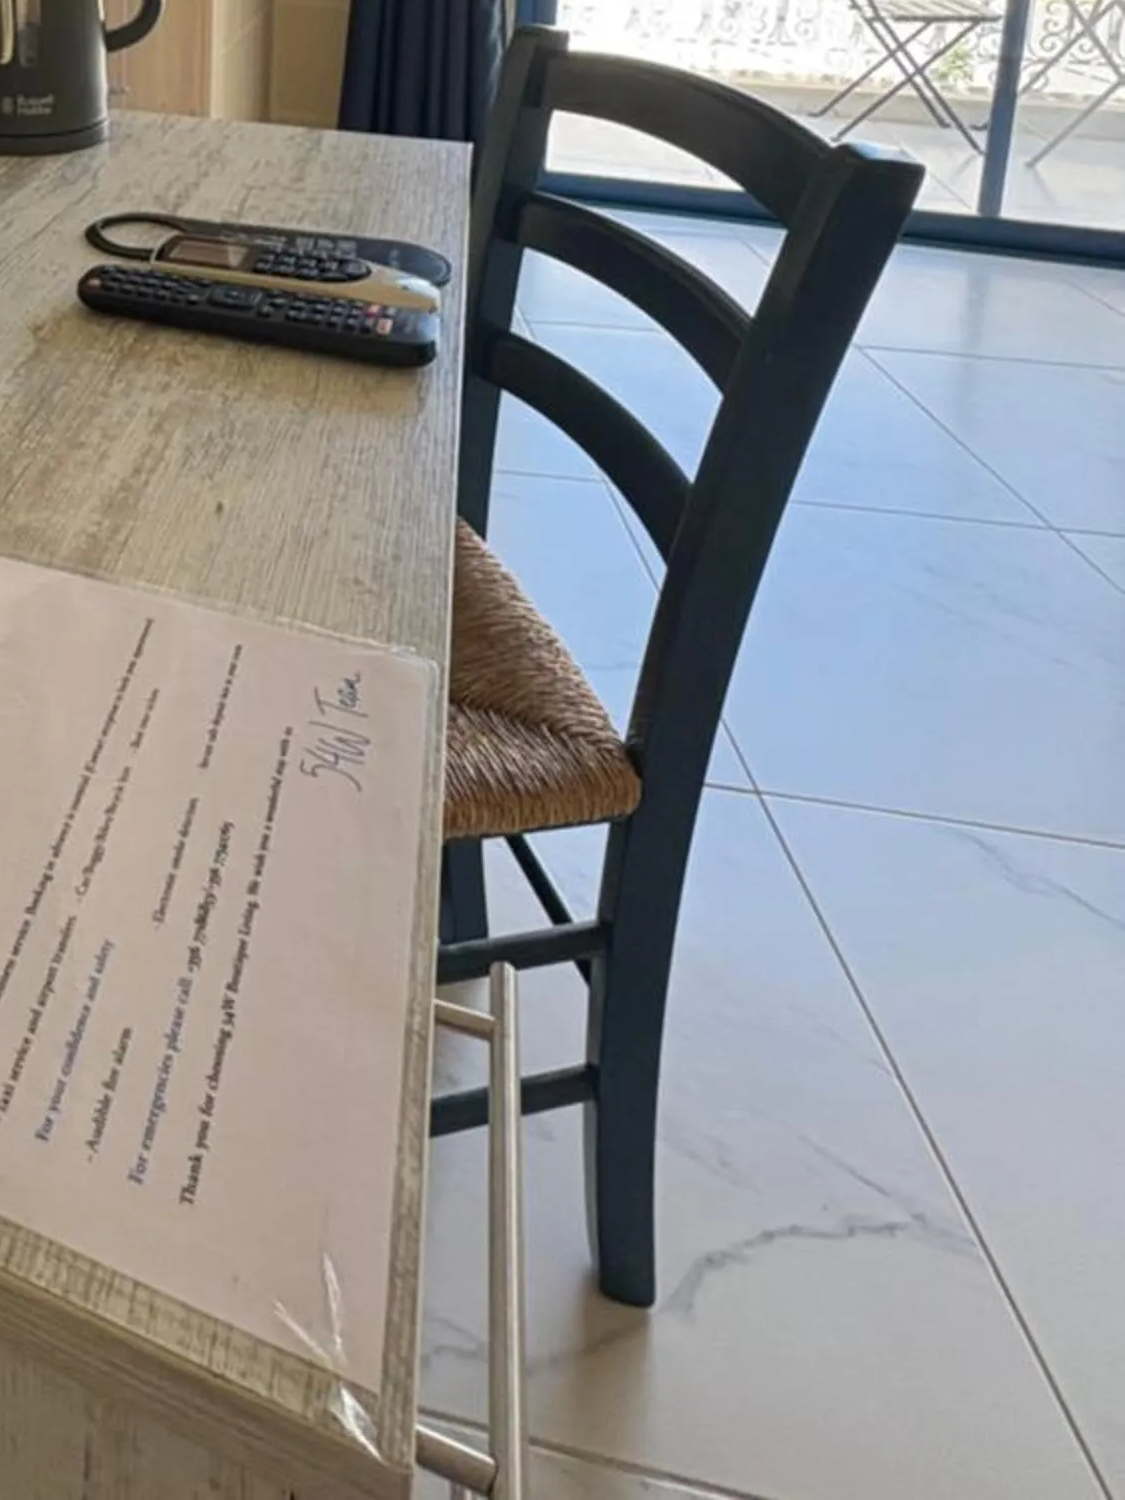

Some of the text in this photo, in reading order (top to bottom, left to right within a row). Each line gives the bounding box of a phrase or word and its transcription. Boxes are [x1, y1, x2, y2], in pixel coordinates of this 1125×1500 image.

[299, 718, 372, 793] 54W
[126, 1152, 149, 1186] For
[178, 1153, 203, 1205] Thank
